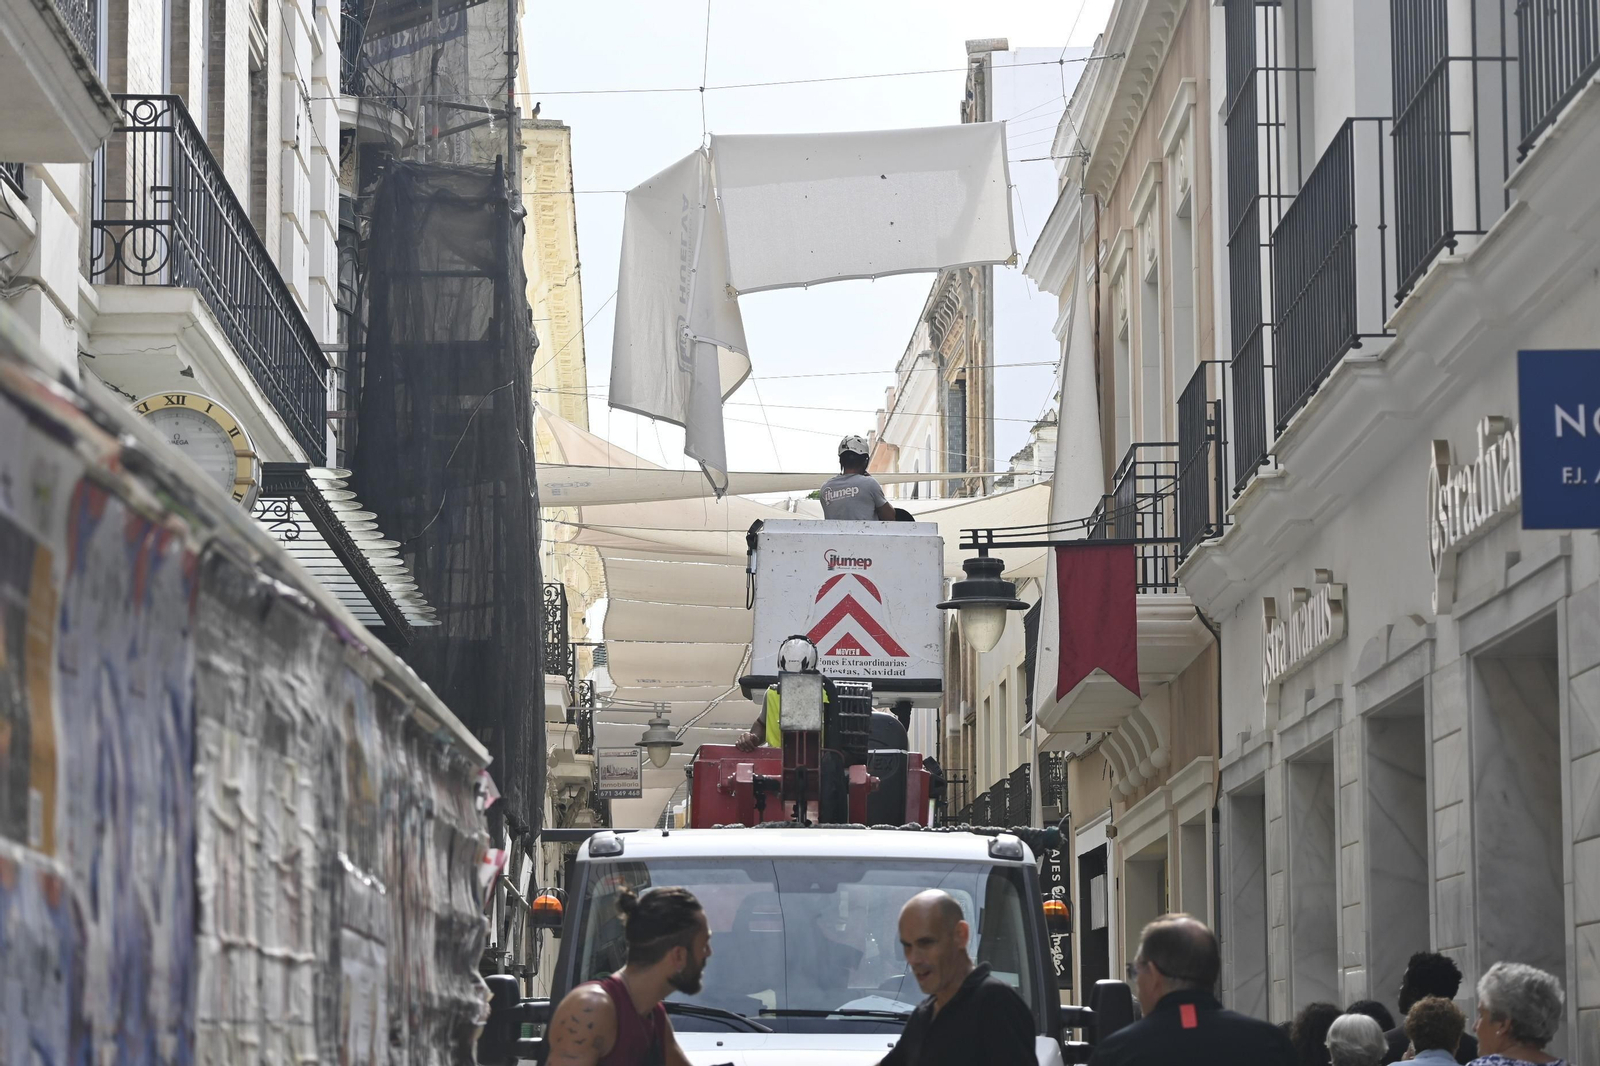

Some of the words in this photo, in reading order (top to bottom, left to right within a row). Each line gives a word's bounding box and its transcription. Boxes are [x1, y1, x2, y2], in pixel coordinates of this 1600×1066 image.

[163, 395, 187, 406] XII
[1554, 404, 1600, 437] N
[842, 657, 907, 667] Extraordinarias:
[864, 668, 906, 676] Navidad
[1050, 848, 1061, 881] AJES
